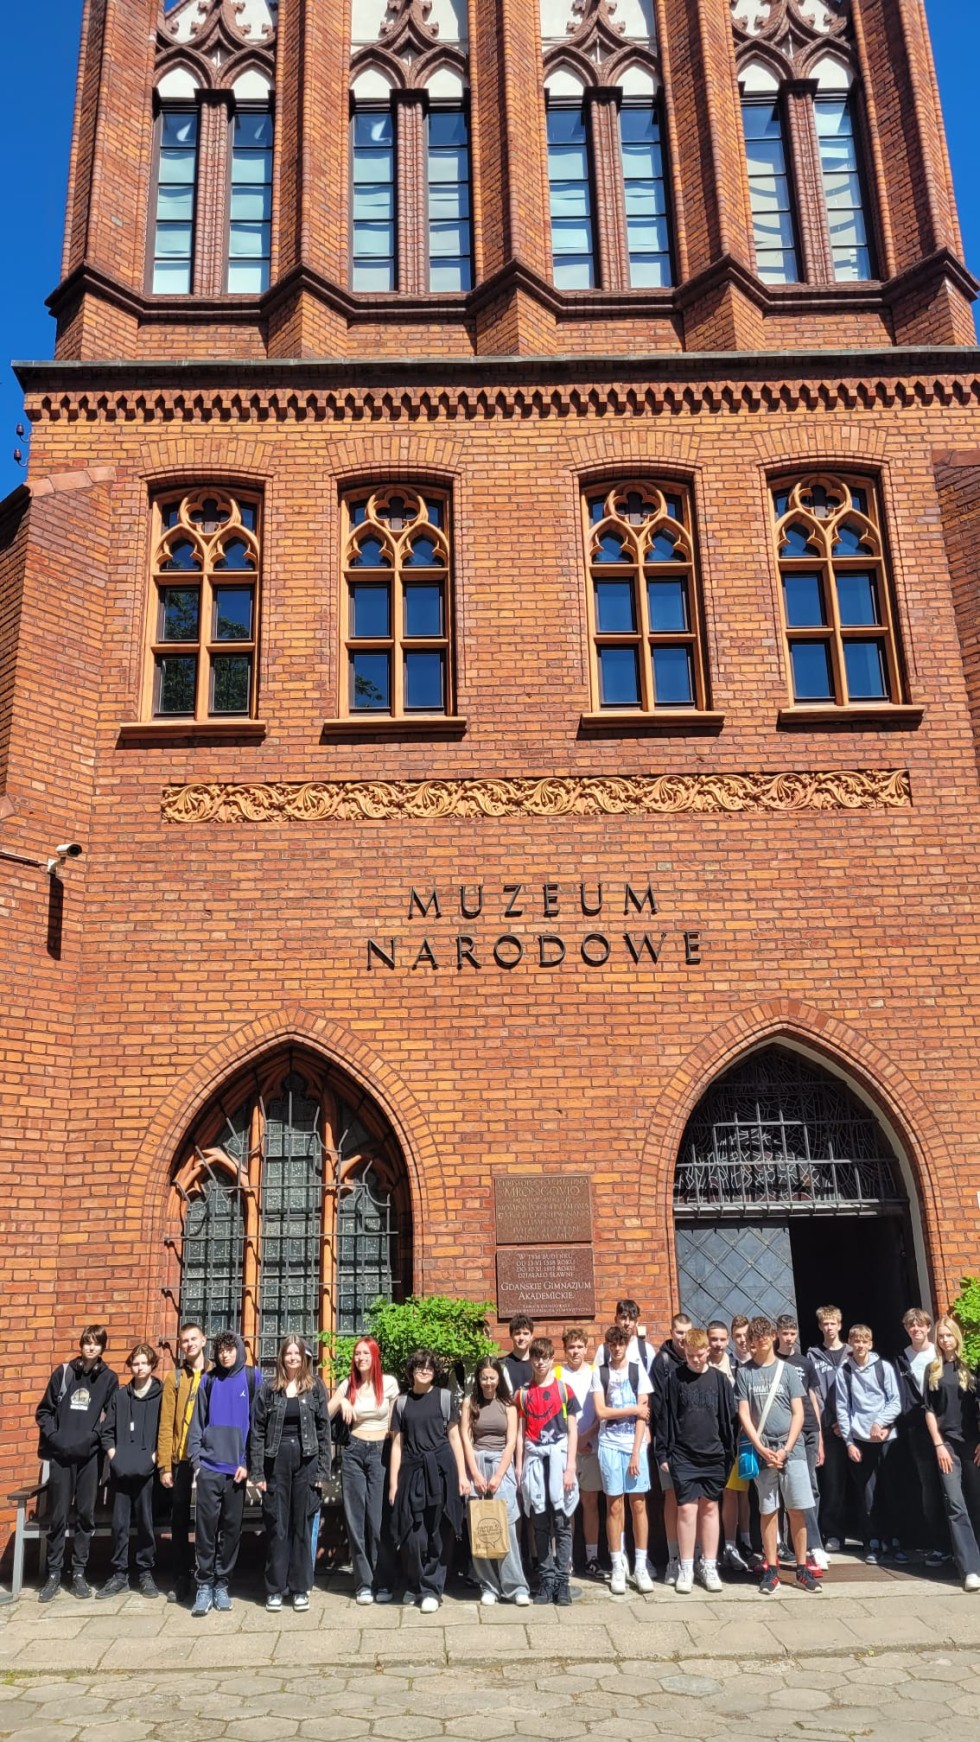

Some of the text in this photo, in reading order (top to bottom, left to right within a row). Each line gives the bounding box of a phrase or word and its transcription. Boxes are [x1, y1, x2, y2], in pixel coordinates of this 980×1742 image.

[408, 882, 657, 920] MUZEUM
[366, 930, 701, 970] NARODOWE
[518, 1291, 575, 1300] AKADEMICKIE
